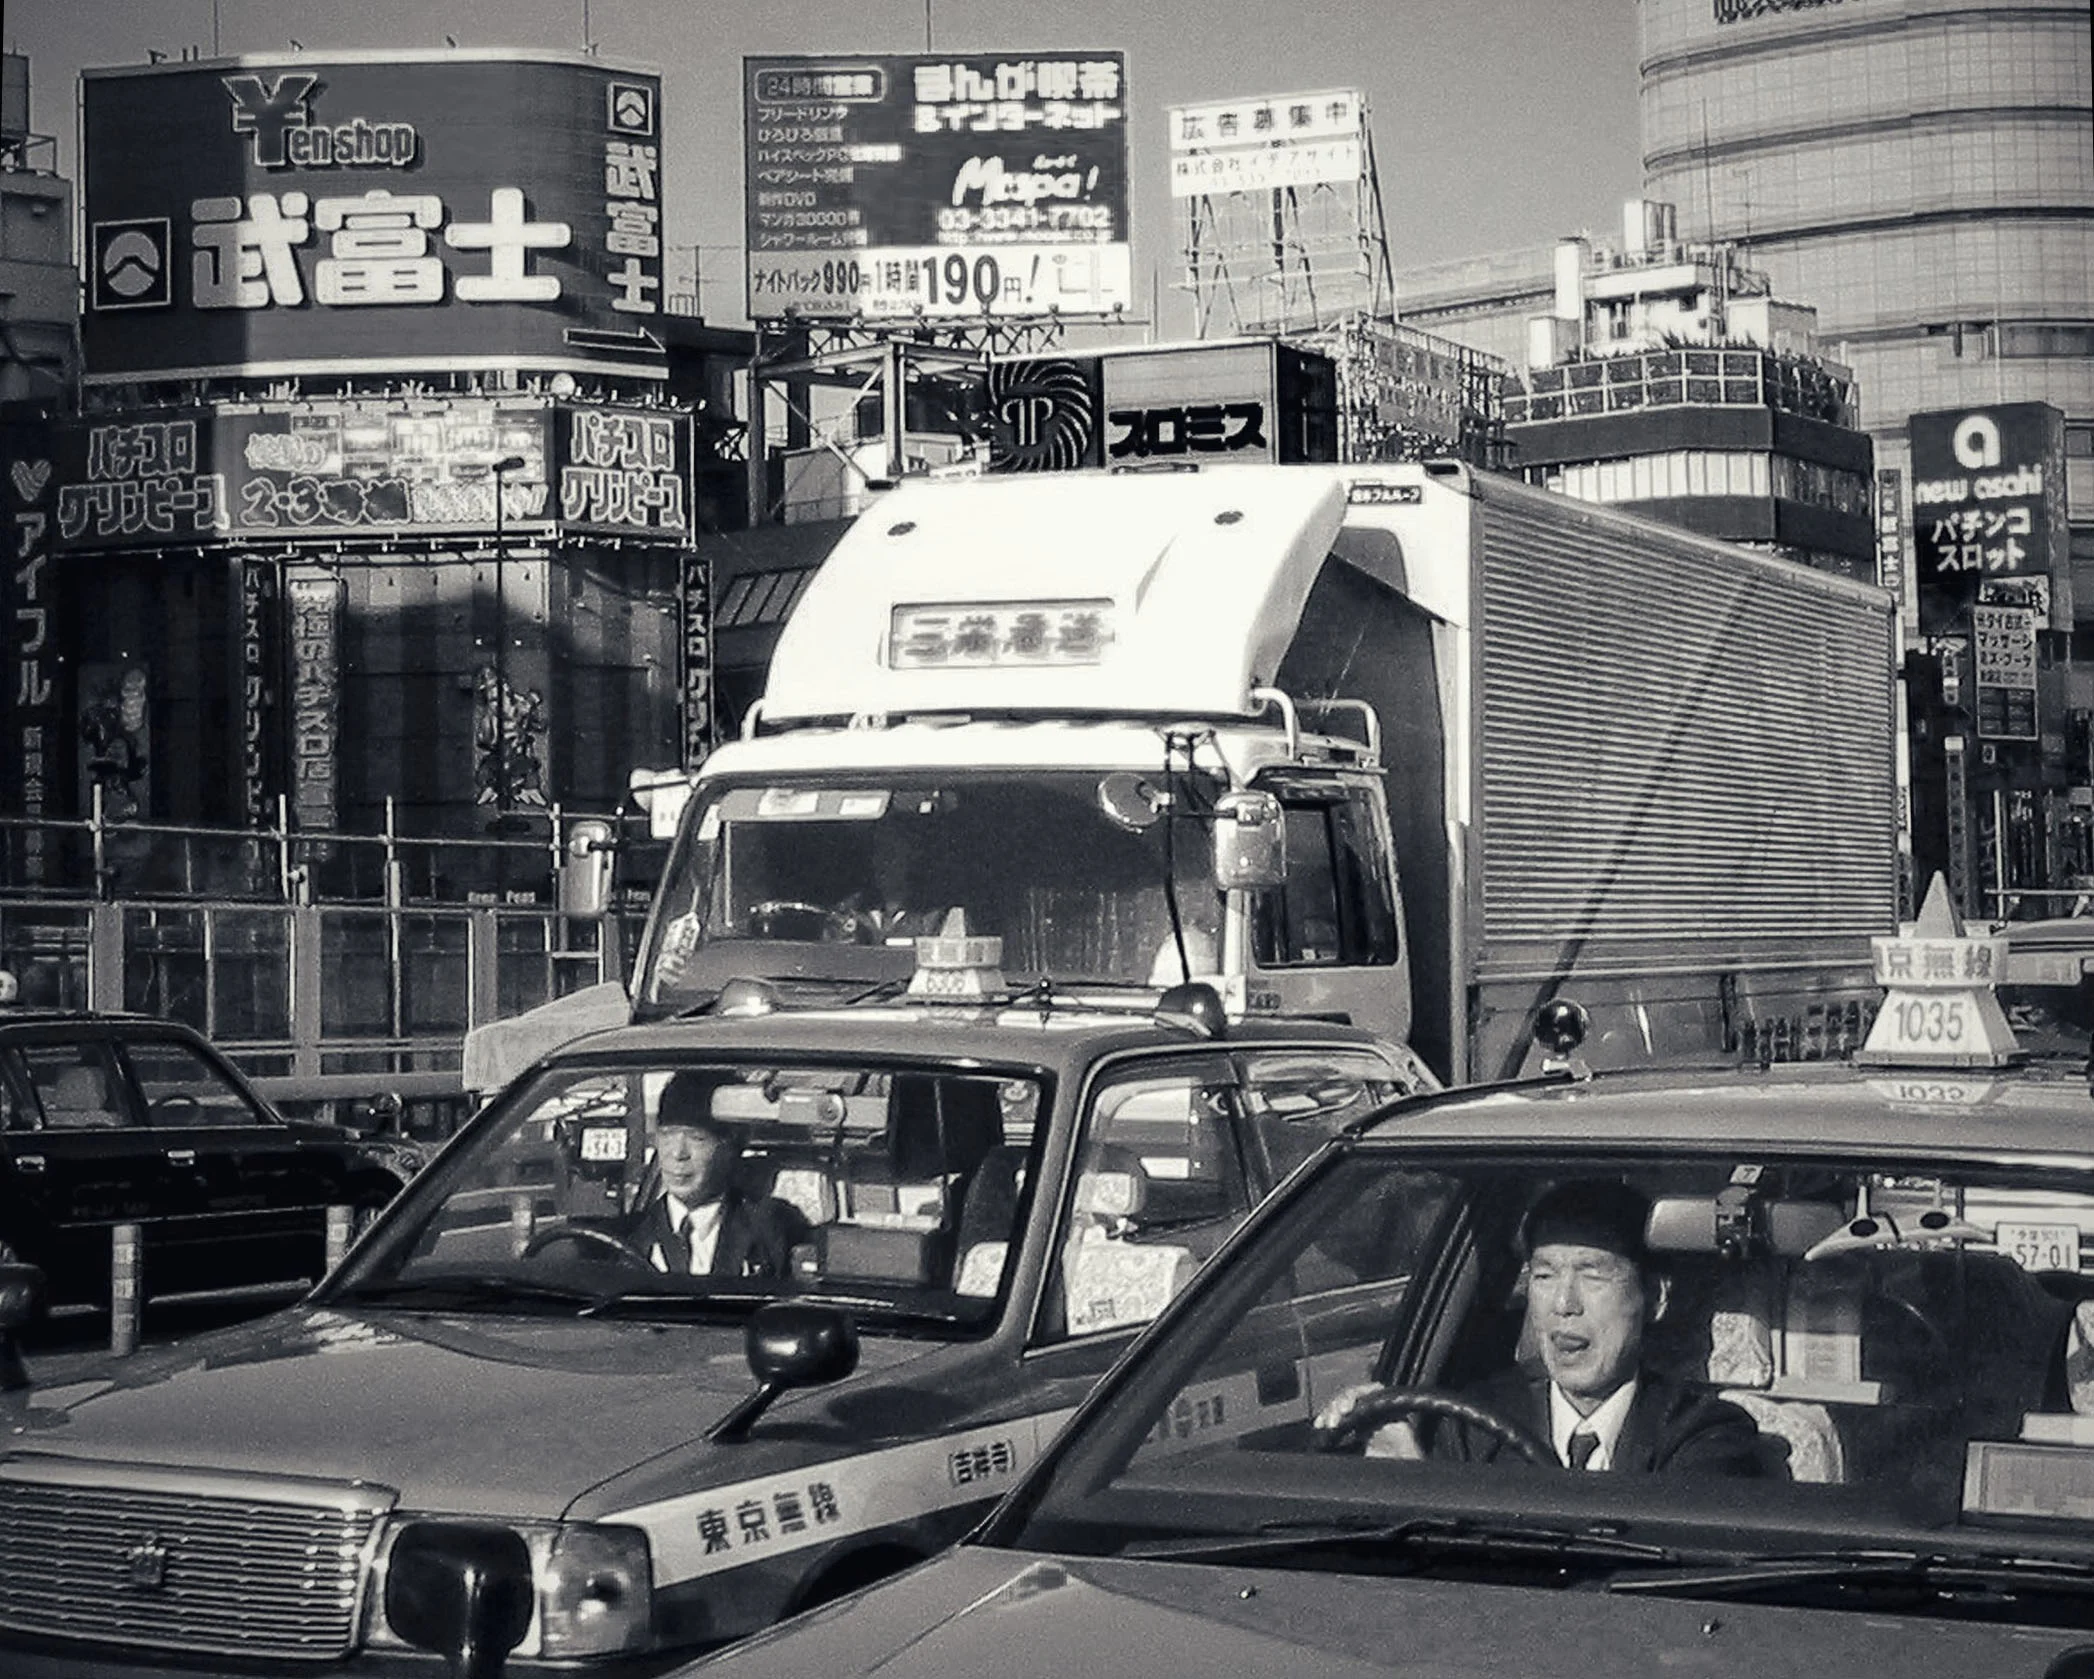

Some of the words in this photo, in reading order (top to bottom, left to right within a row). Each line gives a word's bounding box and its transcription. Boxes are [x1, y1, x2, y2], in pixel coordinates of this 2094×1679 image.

[757, 104, 848, 121] フリードリンク
[191, 187, 571, 308] 武富士
[605, 141, 659, 314] 武富士
[570, 411, 673, 471] パチスロ
[1931, 507, 2031, 543] パチンコ
[1936, 537, 2026, 572] スロット
[14, 512, 51, 706] アイフル
[1894, 1001, 1964, 1042] 1035
[697, 1481, 841, 1555] 東京無線
